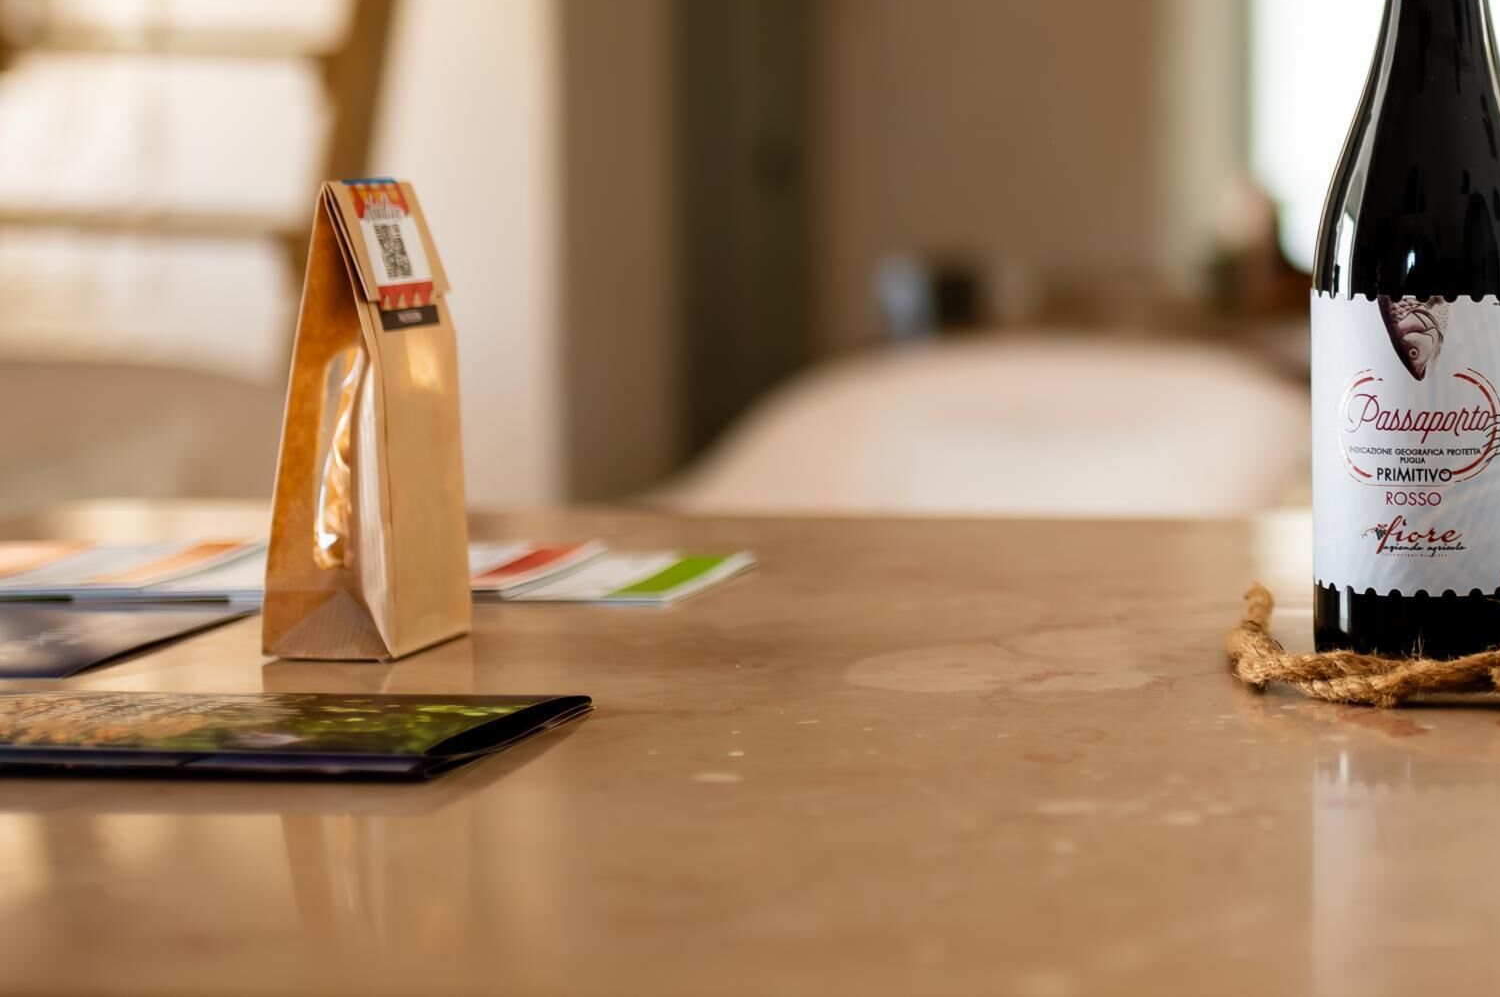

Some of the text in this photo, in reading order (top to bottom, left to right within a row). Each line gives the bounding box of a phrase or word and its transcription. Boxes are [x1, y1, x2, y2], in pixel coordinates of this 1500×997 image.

[1345, 393, 1491, 444] Passaporto
[1349, 446, 1481, 456] INDICAZIONE GEOGRAFICA PROTETTA
[1399, 456, 1426, 464] PUGLIA
[1376, 467, 1453, 482] PRIMITIVO
[1386, 491, 1442, 506] ROSSO
